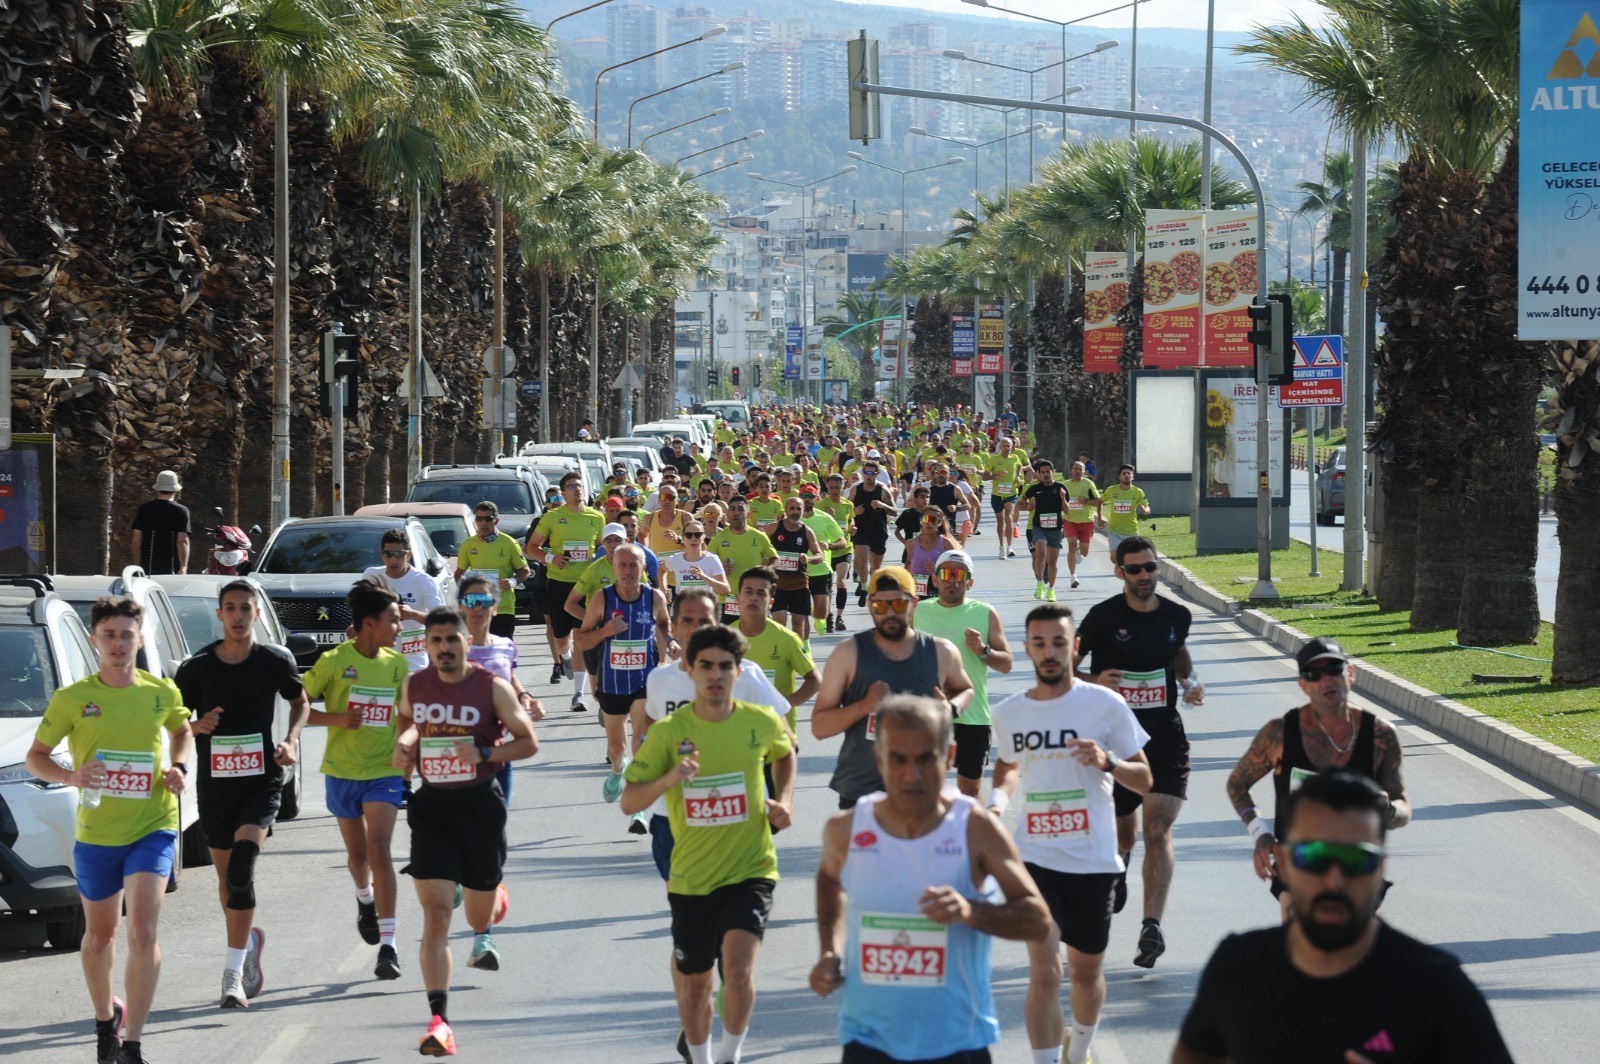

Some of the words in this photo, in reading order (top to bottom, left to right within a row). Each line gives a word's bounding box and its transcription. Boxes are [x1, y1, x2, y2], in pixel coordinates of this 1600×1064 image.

[1239, 237, 1257, 246] 125
[1526, 276, 1570, 295] 444
[1576, 274, 1590, 295] 0
[992, 331, 1003, 340] 80
[1293, 370, 1315, 378] RAMVAY
[1316, 369, 1333, 377] HATTI
[1233, 385, 1276, 396] İRENE
[1288, 388, 1334, 396] İÇERİSİNDE
[1281, 396, 1341, 405] BEKLEMEYİNİZ
[316, 633, 334, 643] AAC
[613, 654, 643, 665] 36153
[1123, 688, 1162, 702] 36212
[353, 704, 388, 720] 6151
[412, 703, 481, 727] BOLD
[1012, 729, 1079, 753] BOLD
[216, 753, 260, 770] 36136
[690, 797, 742, 818] 36411
[1030, 812, 1085, 833] 35389
[865, 947, 940, 976] 35942
